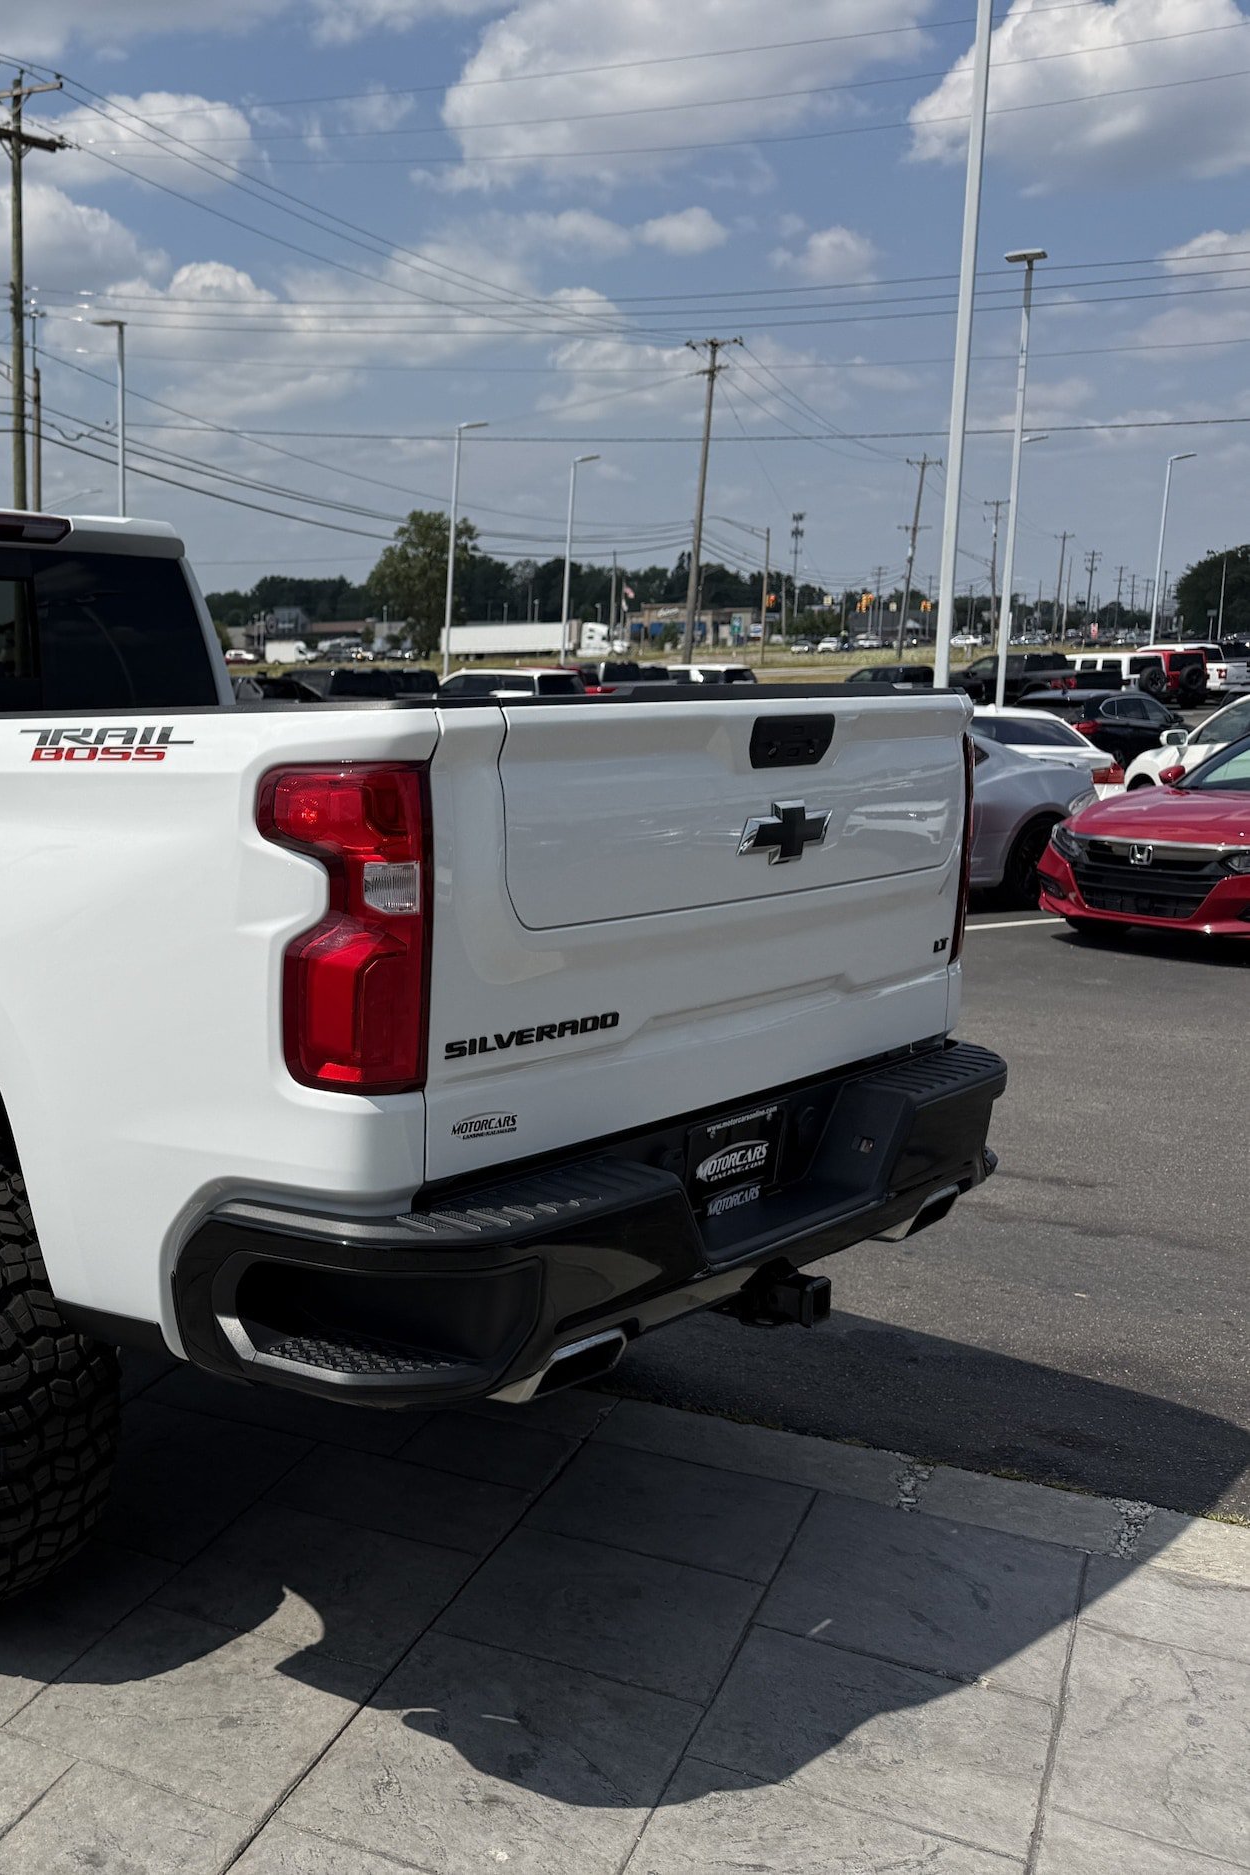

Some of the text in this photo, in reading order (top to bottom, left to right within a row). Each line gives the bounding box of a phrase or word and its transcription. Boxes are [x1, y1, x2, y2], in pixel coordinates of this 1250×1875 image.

[20, 726, 194, 746] TRAIL
[30, 746, 168, 762] BOSS
[932, 937, 950, 953] LT
[444, 1011, 620, 1060] SILVERADO
[450, 1114, 518, 1136] MOTORCARS
[696, 1142, 769, 1180] MOTORCARS
[707, 1185, 762, 1217] MOTORCARS
